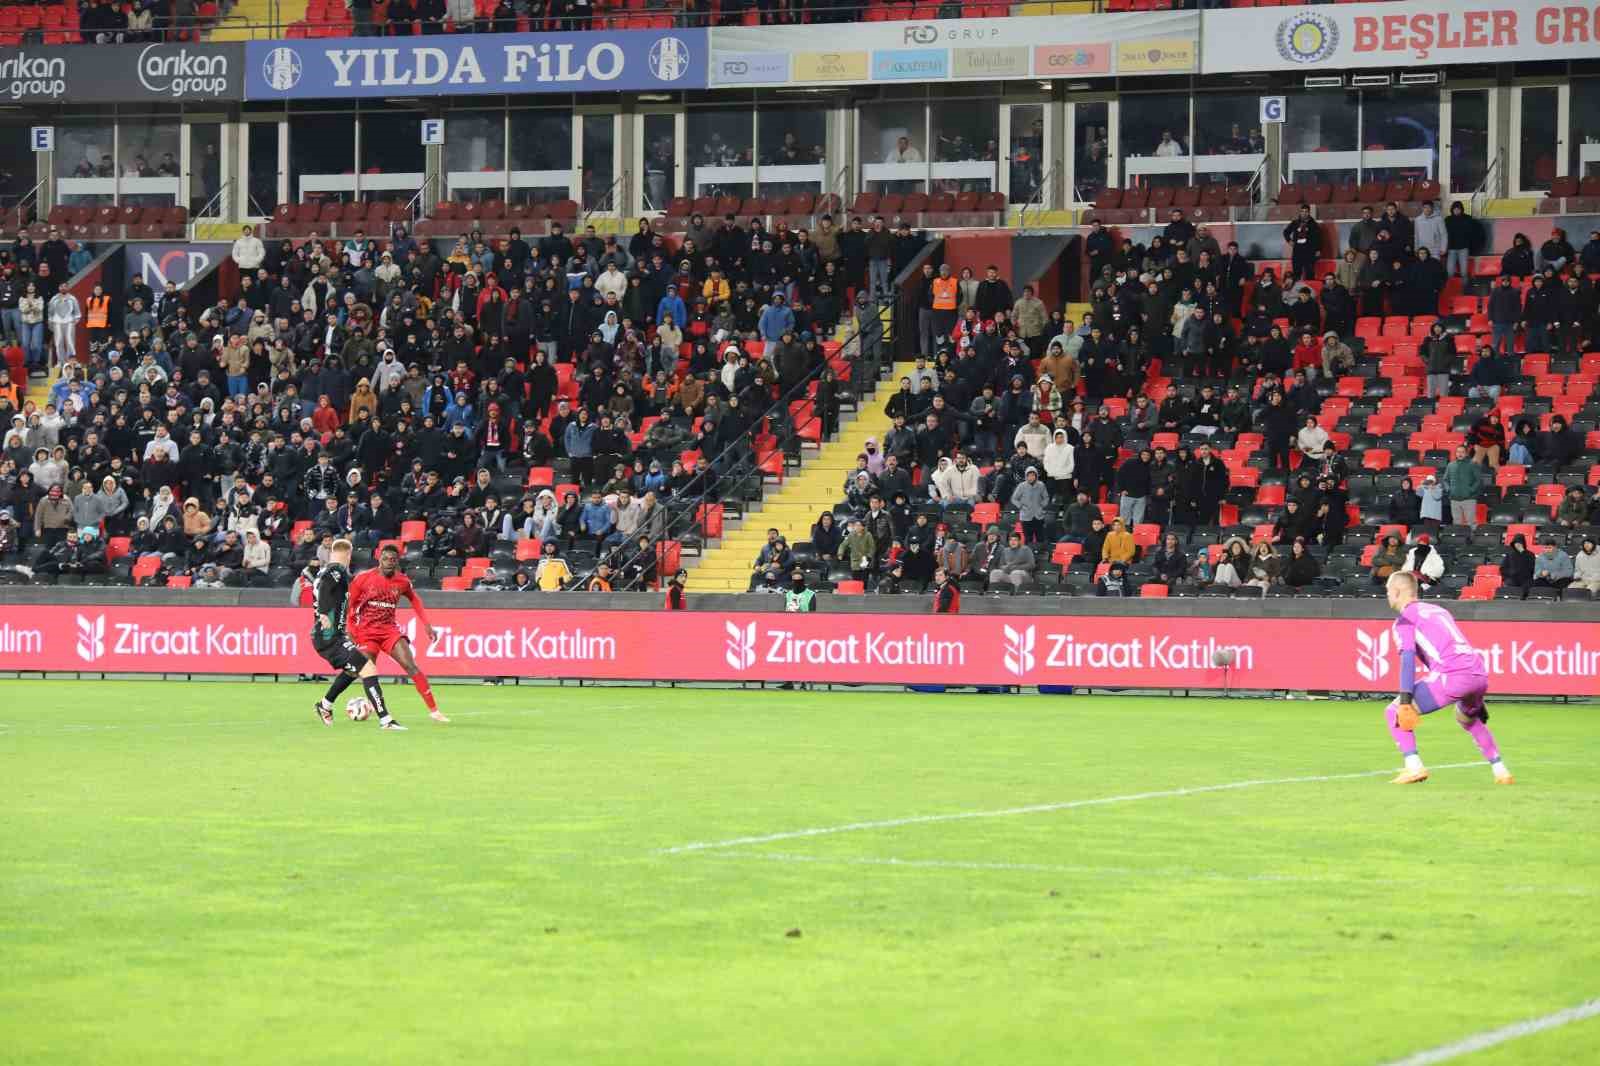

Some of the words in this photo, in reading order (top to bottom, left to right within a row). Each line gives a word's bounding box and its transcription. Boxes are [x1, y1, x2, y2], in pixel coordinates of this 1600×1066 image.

[948, 28, 1000, 40] GRUP
[1353, 10, 1518, 59] BEŞLER
[1536, 6, 1600, 45] GR
[0, 52, 65, 78] rıkan
[325, 46, 486, 87] YILDA
[11, 80, 65, 99] group
[172, 77, 226, 96] group
[1265, 100, 1281, 119] G
[36, 130, 48, 149] E
[426, 122, 438, 141] F
[114, 623, 200, 655] Ziraat
[206, 624, 297, 656] Katılım
[426, 626, 515, 658] Ziraat
[521, 627, 616, 660] Katılım
[766, 630, 859, 664] Ziraat
[866, 632, 965, 665] Katılım
[1045, 634, 1143, 668] Ziraat
